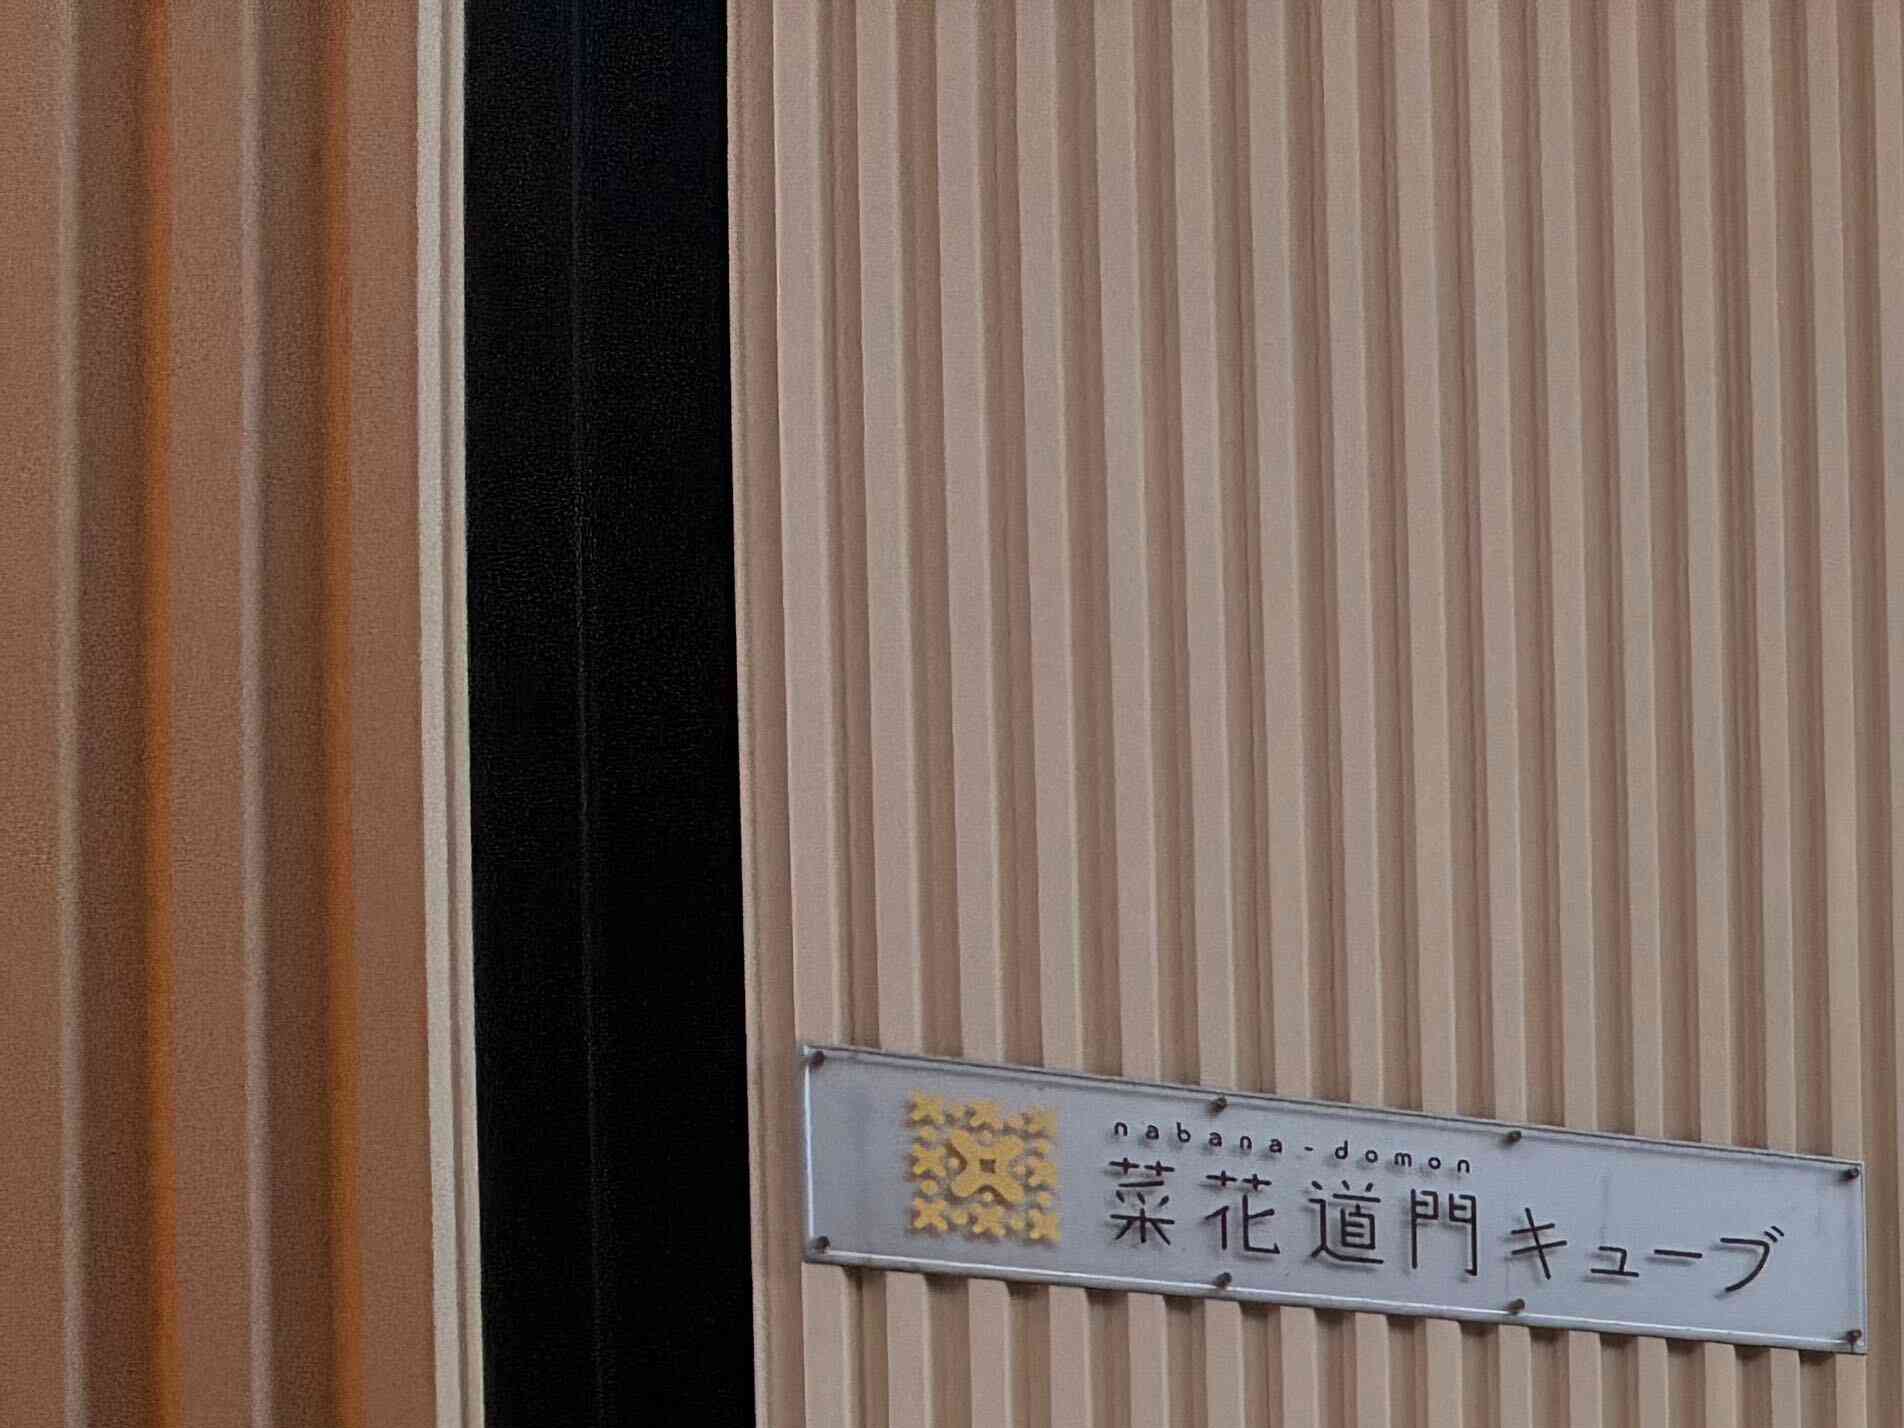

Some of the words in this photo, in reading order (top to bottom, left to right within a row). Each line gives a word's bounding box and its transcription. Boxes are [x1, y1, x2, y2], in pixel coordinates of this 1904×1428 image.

[1113, 1121, 1471, 1174] nabana-domon
[1108, 1157, 1784, 1293] 菜花道門キューブ
